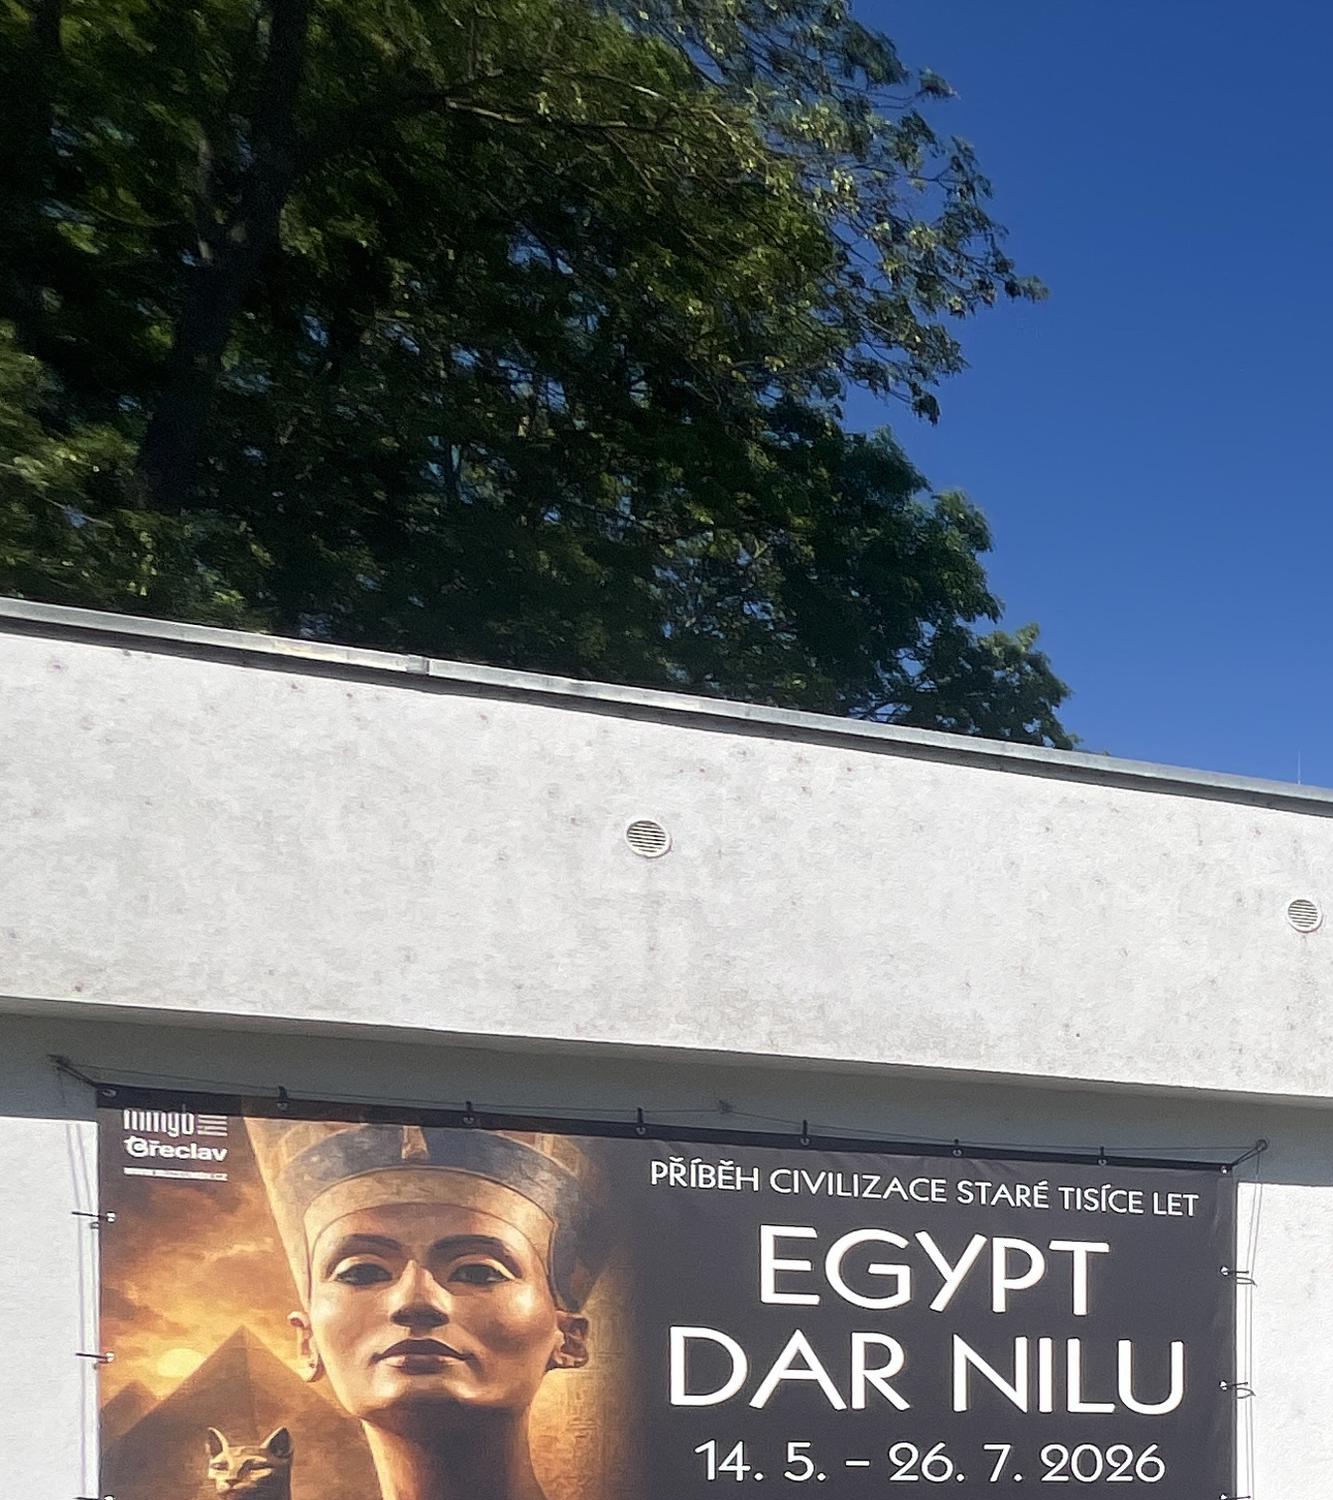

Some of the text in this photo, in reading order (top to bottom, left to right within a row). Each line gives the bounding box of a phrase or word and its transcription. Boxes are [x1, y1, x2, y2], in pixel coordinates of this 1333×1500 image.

[651, 1156, 1200, 1217] PŘÍBĚH CIVILIZACE STARÉ TISÍCE LET
[760, 1224, 1110, 1316] EGYPT
[670, 1326, 1184, 1415] DAR NILU
[694, 1440, 764, 1482] 14.
[784, 1442, 826, 1482] 5.
[888, 1442, 965, 1482] 26.
[983, 1444, 1023, 1482] 7.
[1040, 1444, 1166, 1483] 2026
